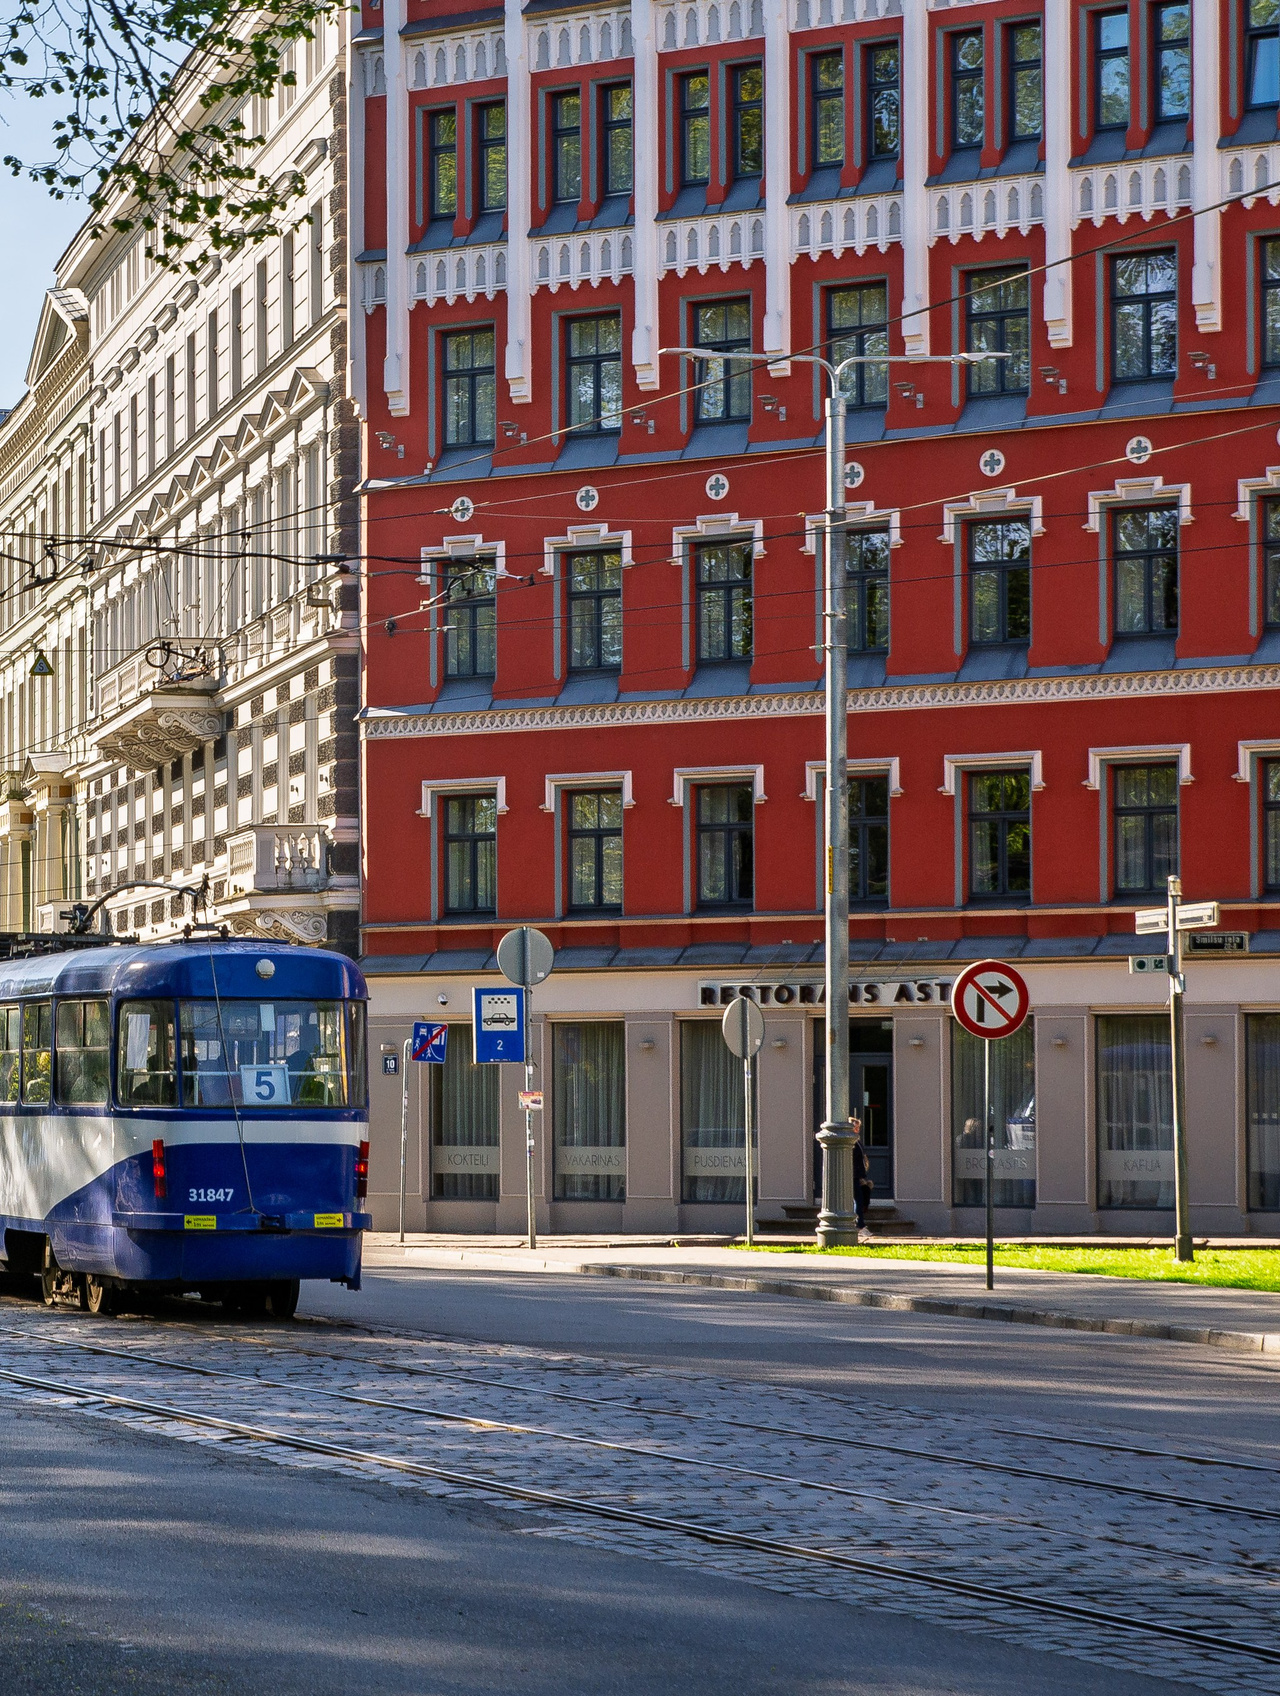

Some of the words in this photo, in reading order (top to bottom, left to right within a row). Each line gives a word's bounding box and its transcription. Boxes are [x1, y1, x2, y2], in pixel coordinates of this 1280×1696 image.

[38, 662, 44, 671] S
[496, 1040, 503, 1051] 2
[386, 1060, 395, 1069] 10
[255, 1071, 275, 1100] 5
[188, 1188, 234, 1202] 31847
